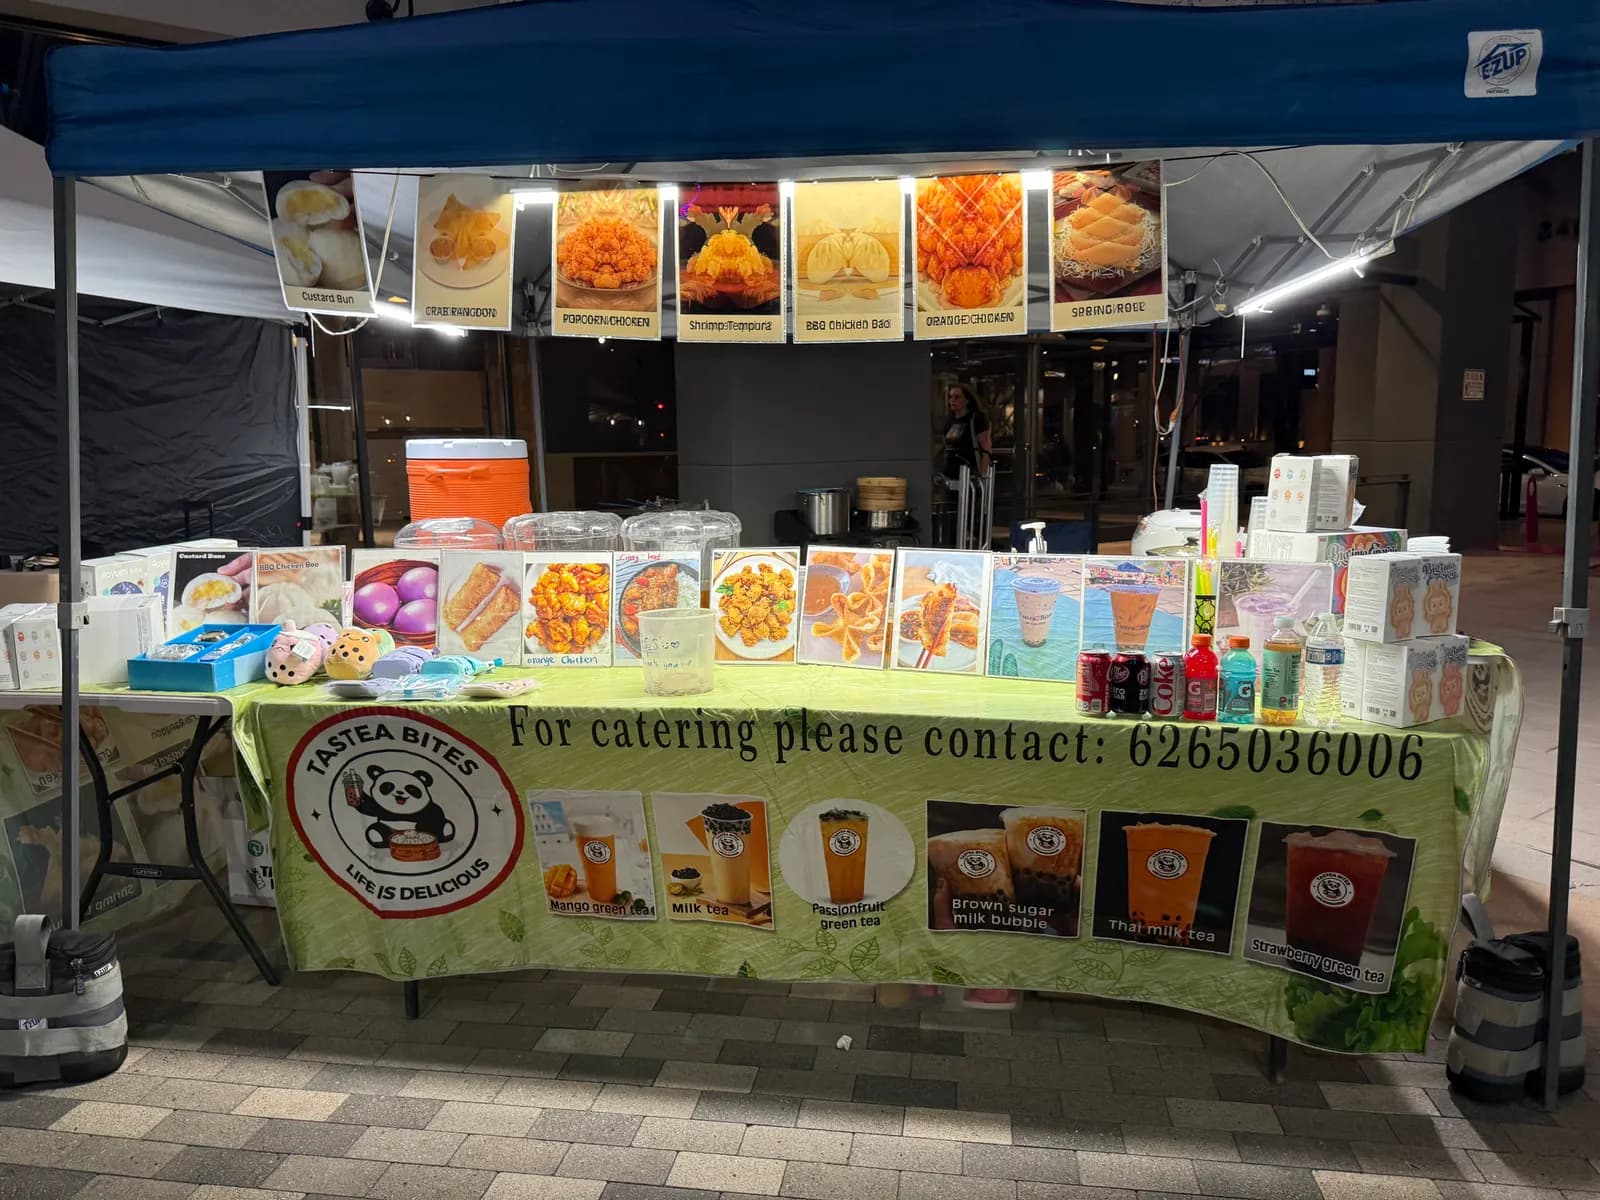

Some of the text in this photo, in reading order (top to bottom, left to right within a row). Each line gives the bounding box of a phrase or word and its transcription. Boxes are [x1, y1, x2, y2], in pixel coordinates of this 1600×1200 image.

[302, 291, 355, 305] Custard Bun
[425, 305, 449, 317] CRAB
[926, 311, 1015, 327] ORANGE CHICKEN
[1072, 305, 1113, 318] SPRING
[562, 313, 650, 328] POPCORN CHICKEN
[689, 319, 725, 333] Shrimp
[828, 318, 869, 331] Chicken
[276, 562, 305, 571] Chicken
[1151, 657, 1175, 715] Coke
[1238, 683, 1252, 698] G
[306, 723, 481, 777] TASTEA BITES
[507, 704, 1425, 780] For catering please contact: 6265036006
[345, 857, 490, 901] LIFE IS DELICIOUS
[550, 899, 649, 916] Mango green tea
[672, 903, 729, 916] Milk tea
[812, 900, 886, 917] Passionfruit
[952, 898, 1055, 918] Brown sugar
[820, 915, 881, 930] green tea
[953, 912, 1049, 930] milk bubble
[1108, 918, 1216, 943] Thai milk tea
[1251, 938, 1386, 984] Strawberry green tea
